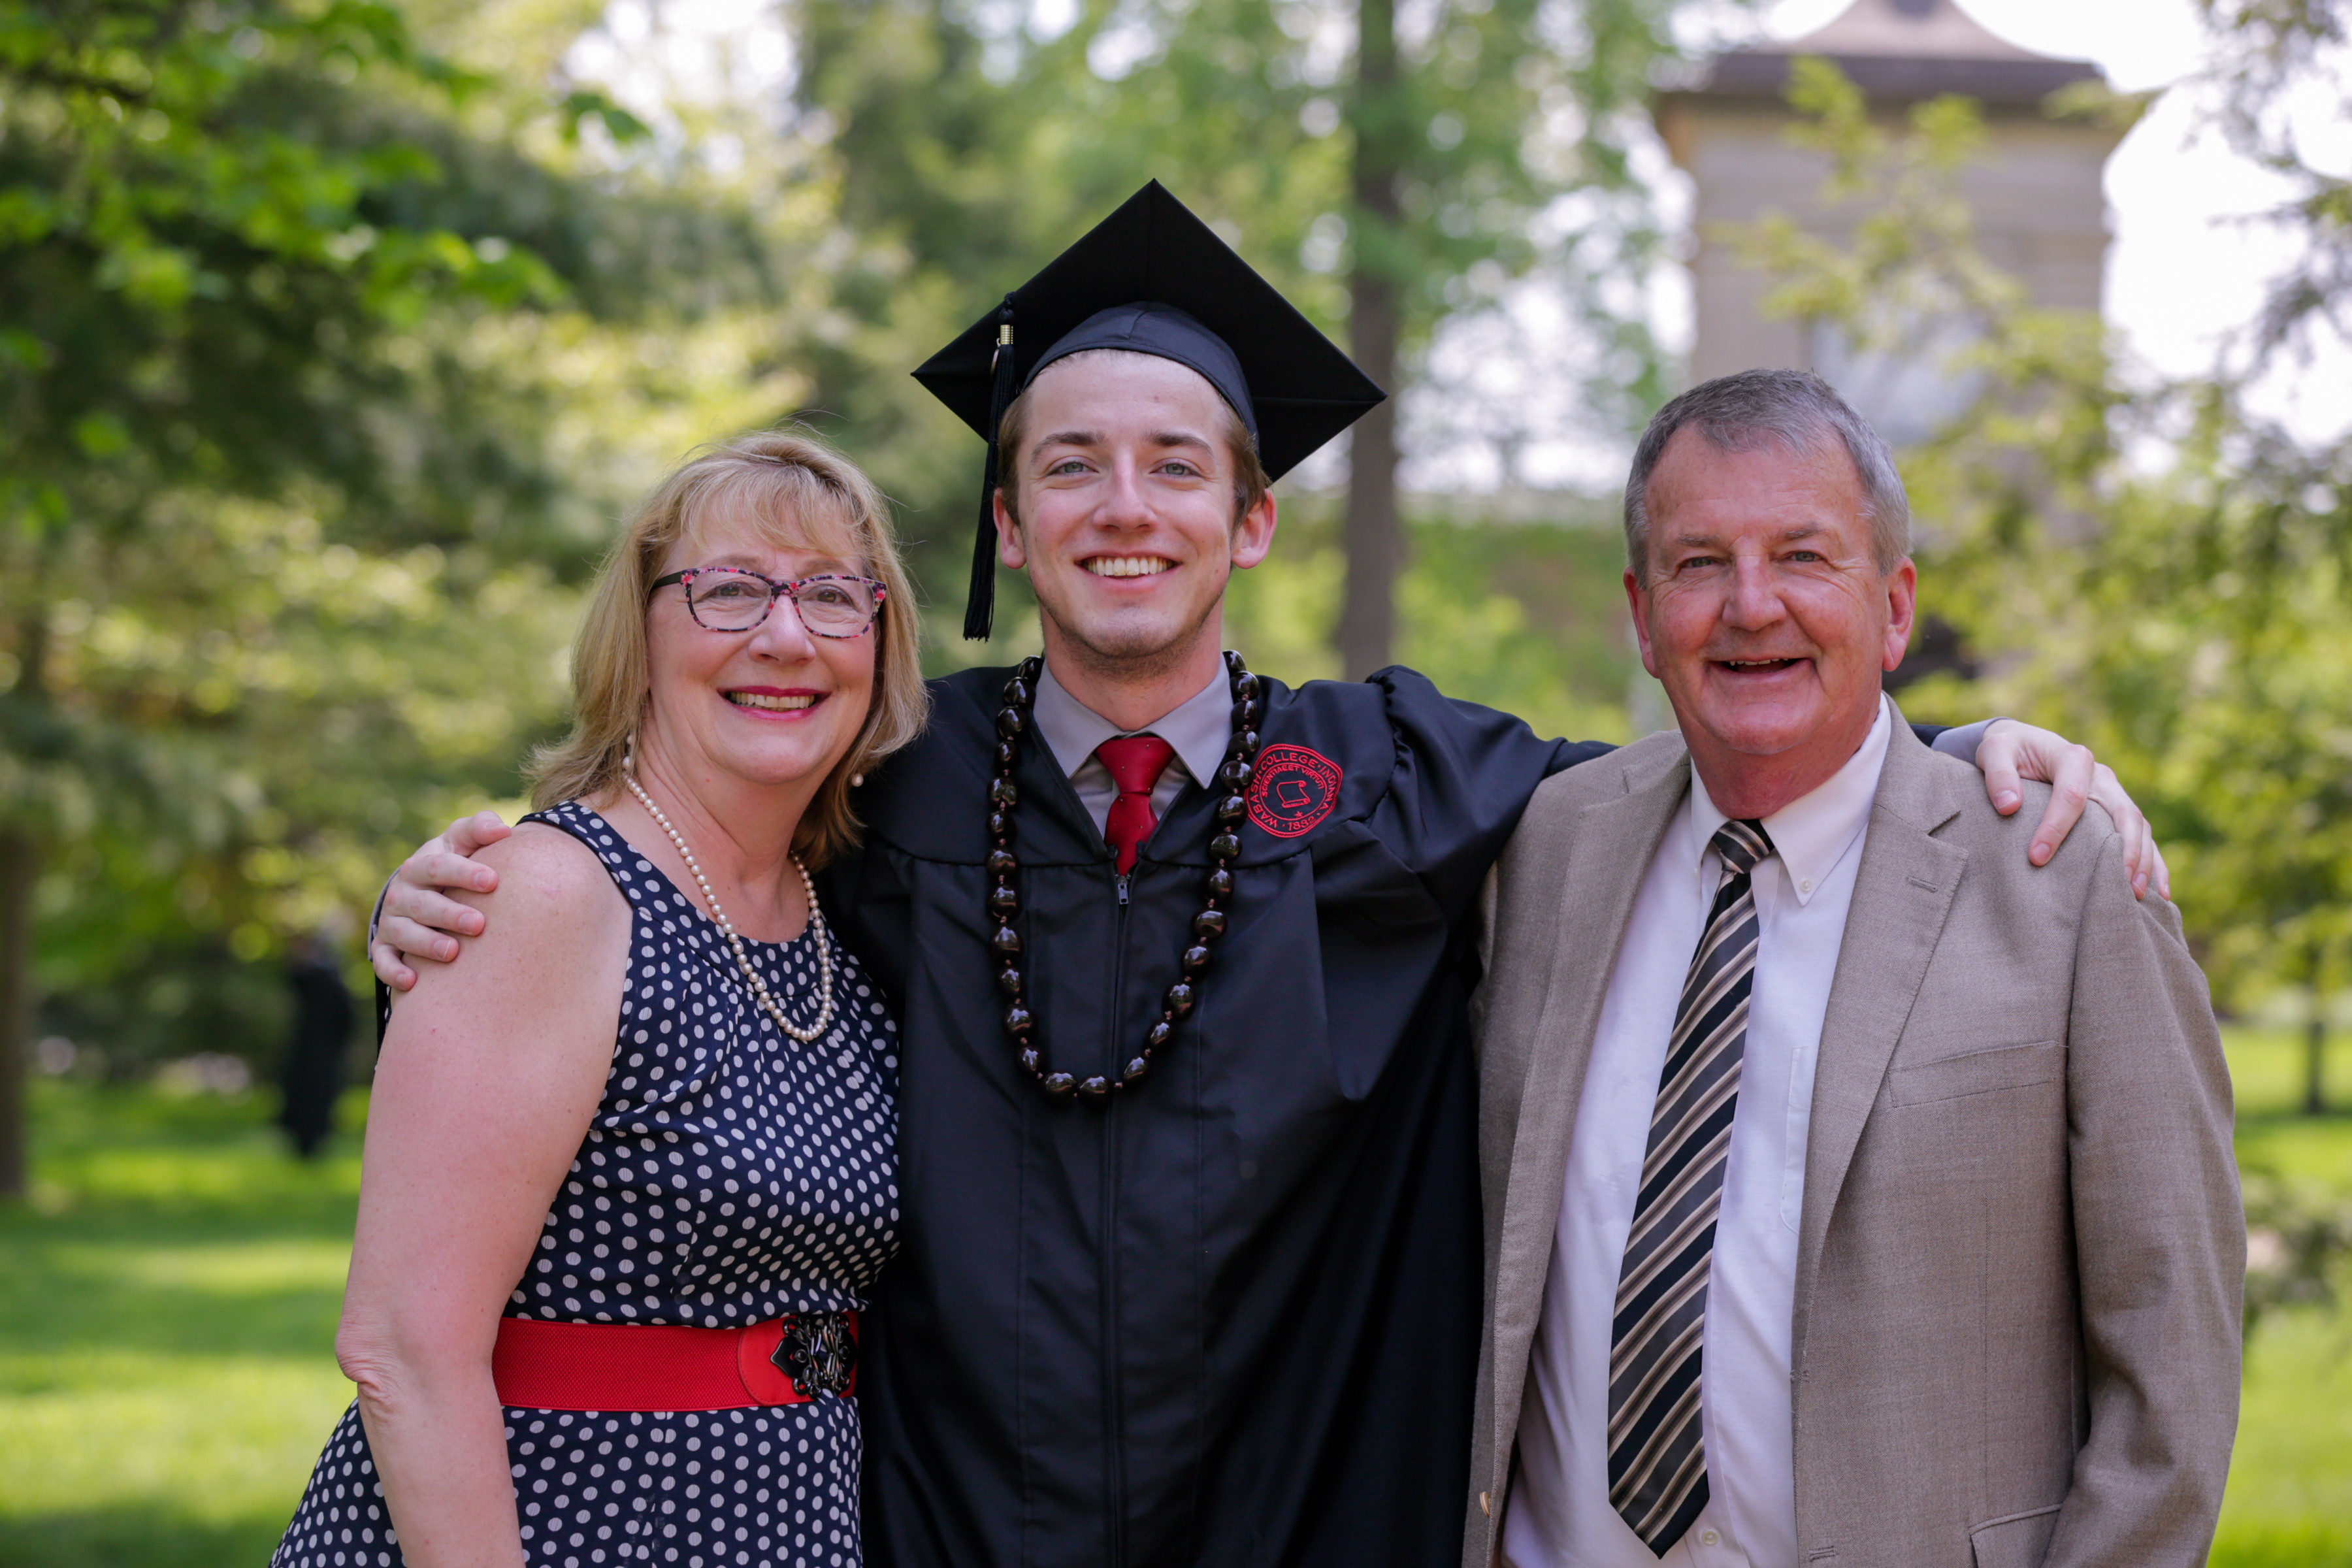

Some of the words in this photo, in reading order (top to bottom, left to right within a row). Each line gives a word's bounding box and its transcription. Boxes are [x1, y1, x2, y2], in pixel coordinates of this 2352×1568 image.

[1261, 752, 1318, 770] COLLEGE
[1301, 767, 1325, 790] VIRTUTI
[1318, 766, 1337, 810] INDIANA
[1250, 773, 1279, 828] WABASH
